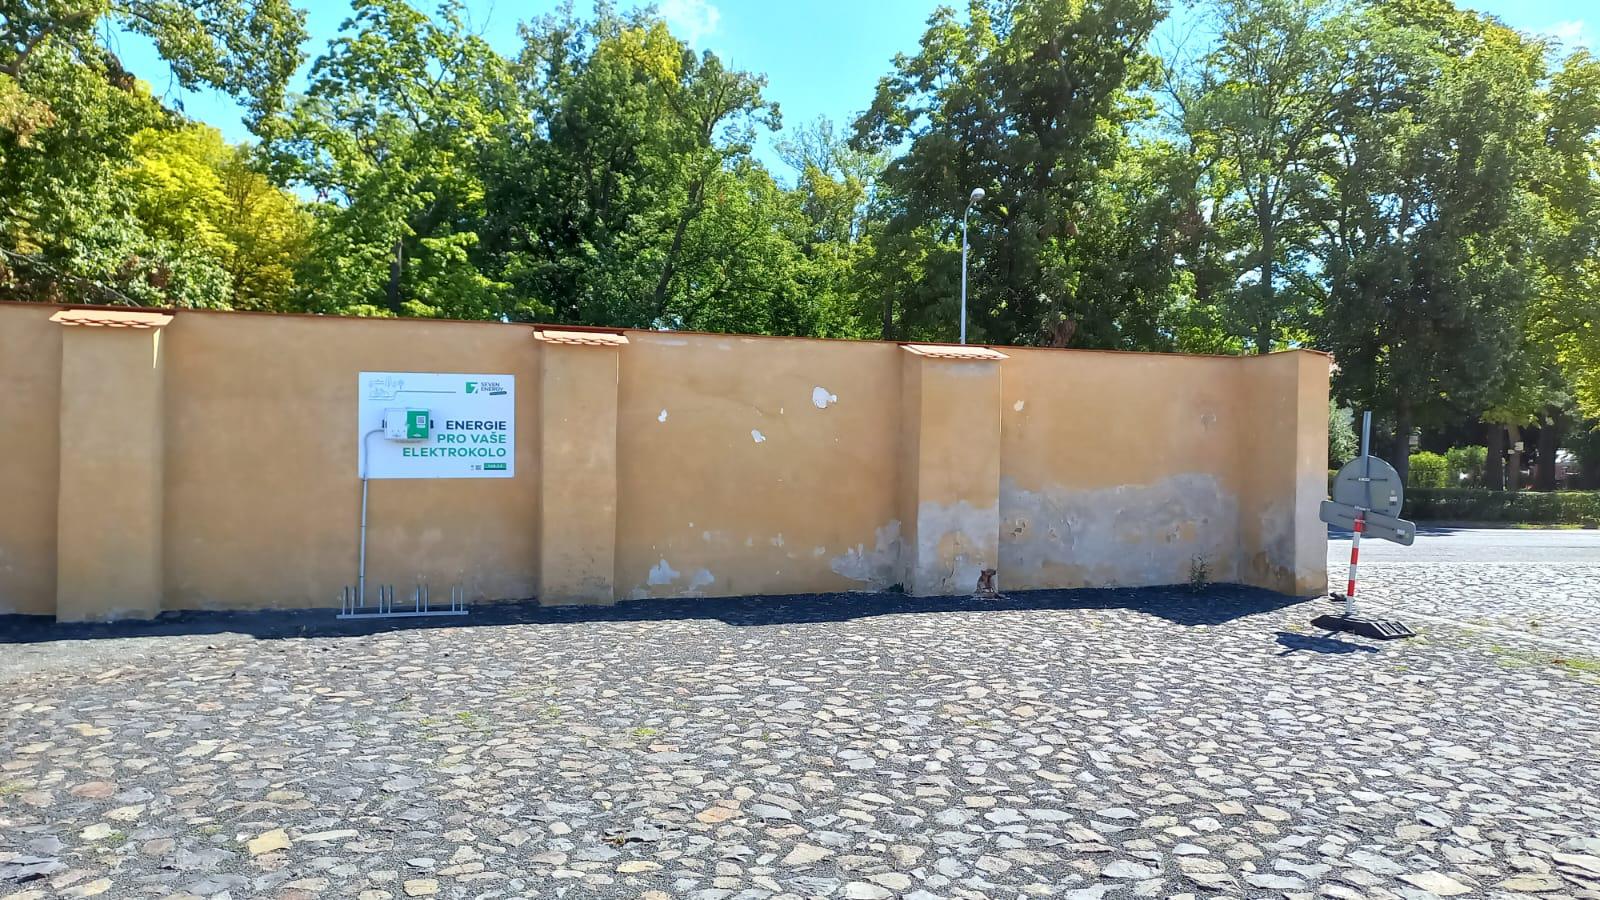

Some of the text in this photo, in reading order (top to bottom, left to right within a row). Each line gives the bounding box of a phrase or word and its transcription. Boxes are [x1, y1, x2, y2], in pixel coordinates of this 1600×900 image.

[446, 420, 507, 430] ENERGIE
[437, 432, 507, 444] PRO VAŠE
[402, 447, 507, 457] ELEKTROKOLO
